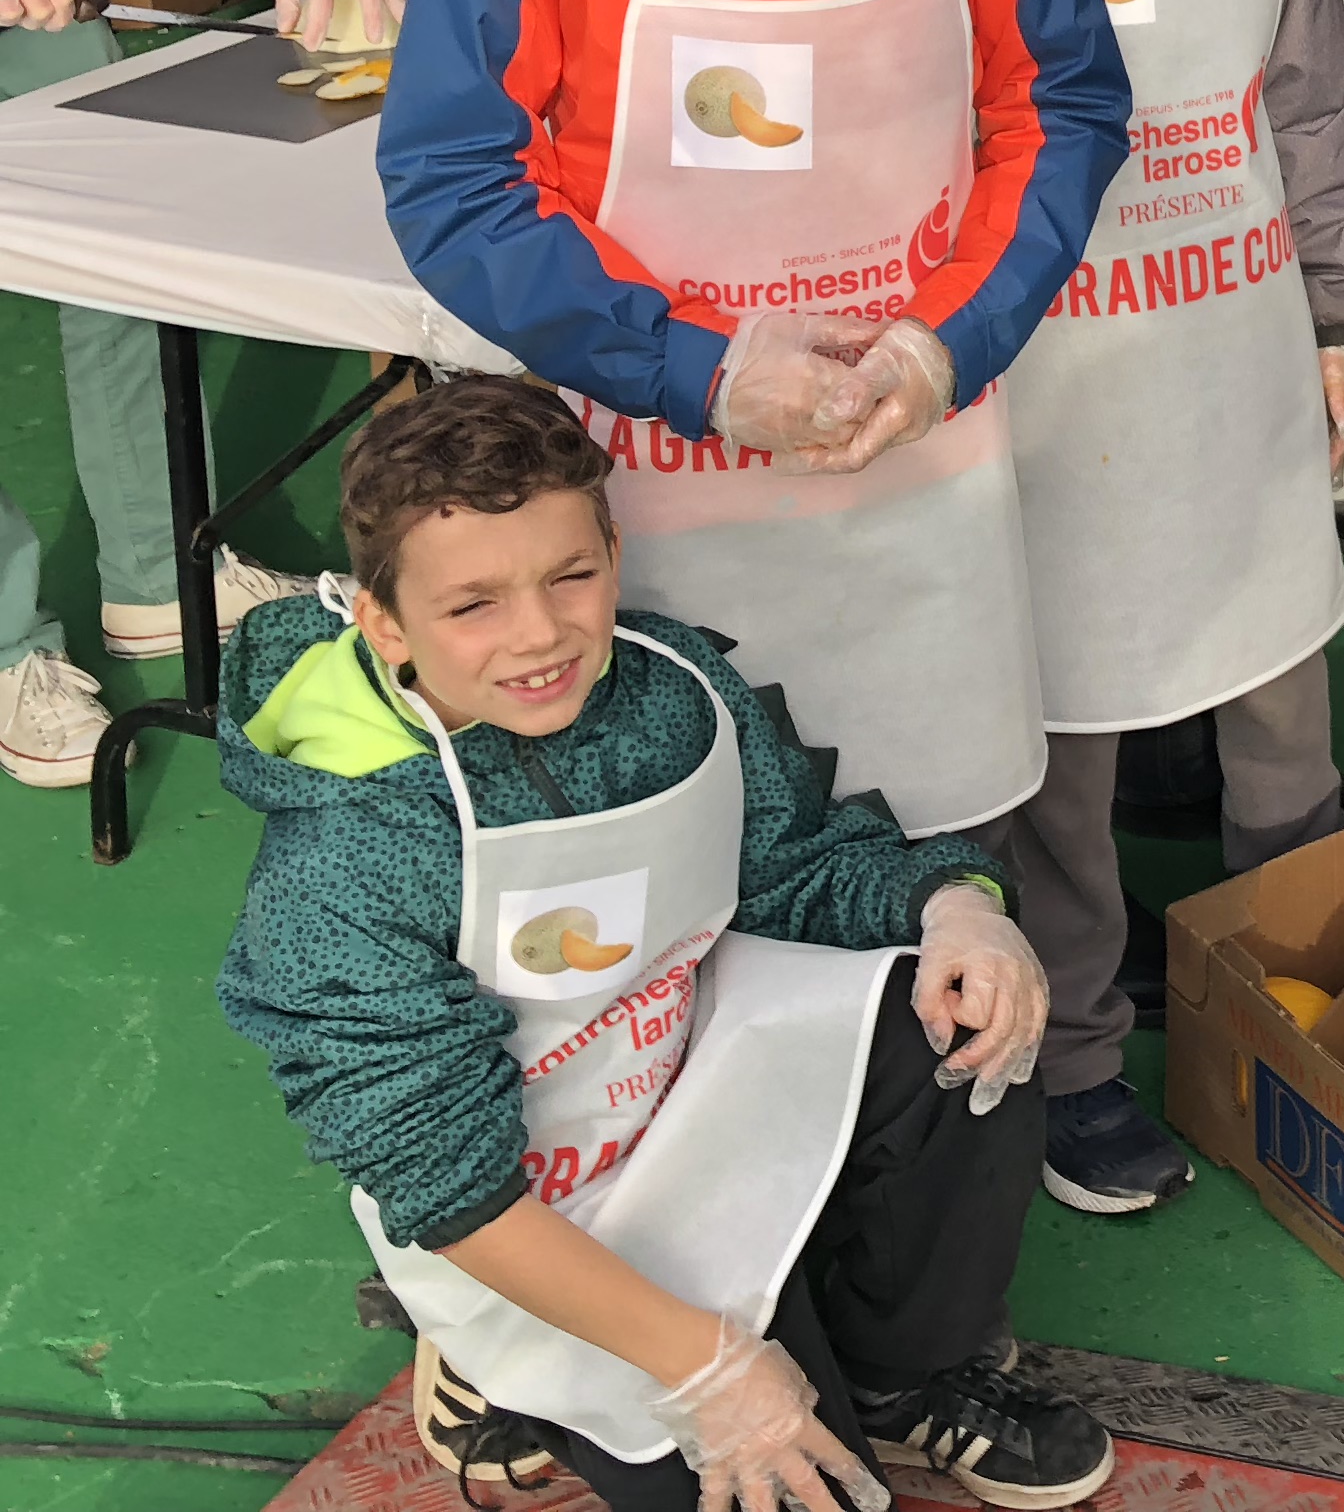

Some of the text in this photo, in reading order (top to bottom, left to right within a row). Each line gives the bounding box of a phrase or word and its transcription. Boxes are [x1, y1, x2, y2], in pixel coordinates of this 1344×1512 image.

[1135, 89, 1236, 118] DEPUIS SINCE 1918
[1143, 144, 1243, 183] larose
[1118, 183, 1245, 228] PRÉSENTE
[782, 233, 902, 270] DEPUIS SINCE 1918
[678, 257, 904, 310] courchesne
